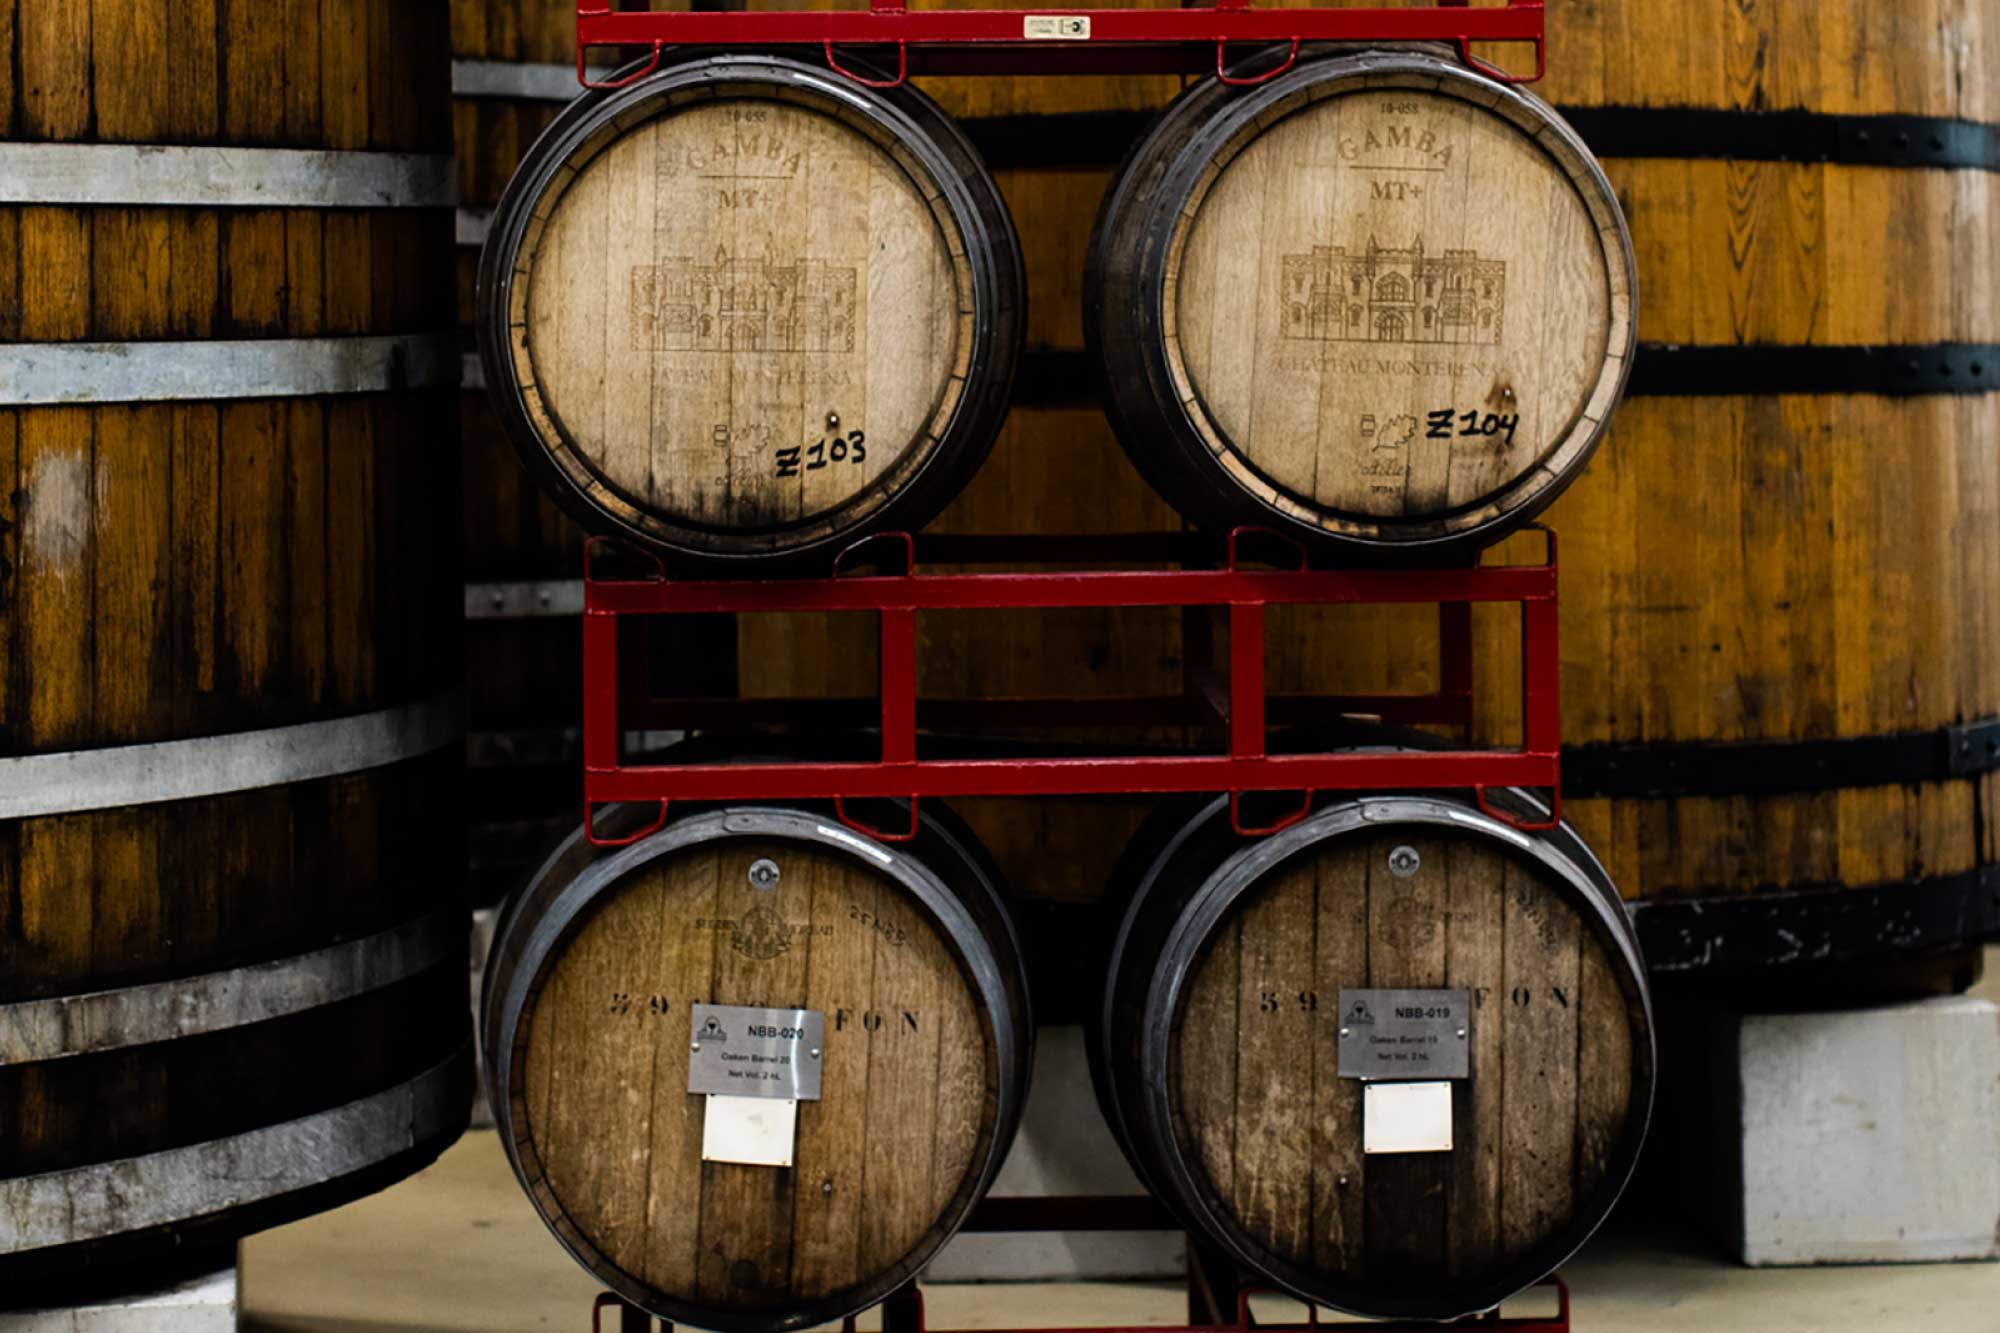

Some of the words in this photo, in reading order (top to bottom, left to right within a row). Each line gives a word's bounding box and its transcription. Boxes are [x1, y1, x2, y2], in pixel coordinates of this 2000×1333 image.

[687, 134, 801, 174] GAMBA
[1338, 125, 1455, 167] GAMBA
[1370, 180, 1424, 201] MT+
[1426, 409, 1519, 446] Z104
[776, 430, 866, 477] Z103
[1395, 1007, 1450, 1019] NBB-019
[748, 1025, 804, 1039] NBB-020
[751, 1054, 778, 1063] Barrel
